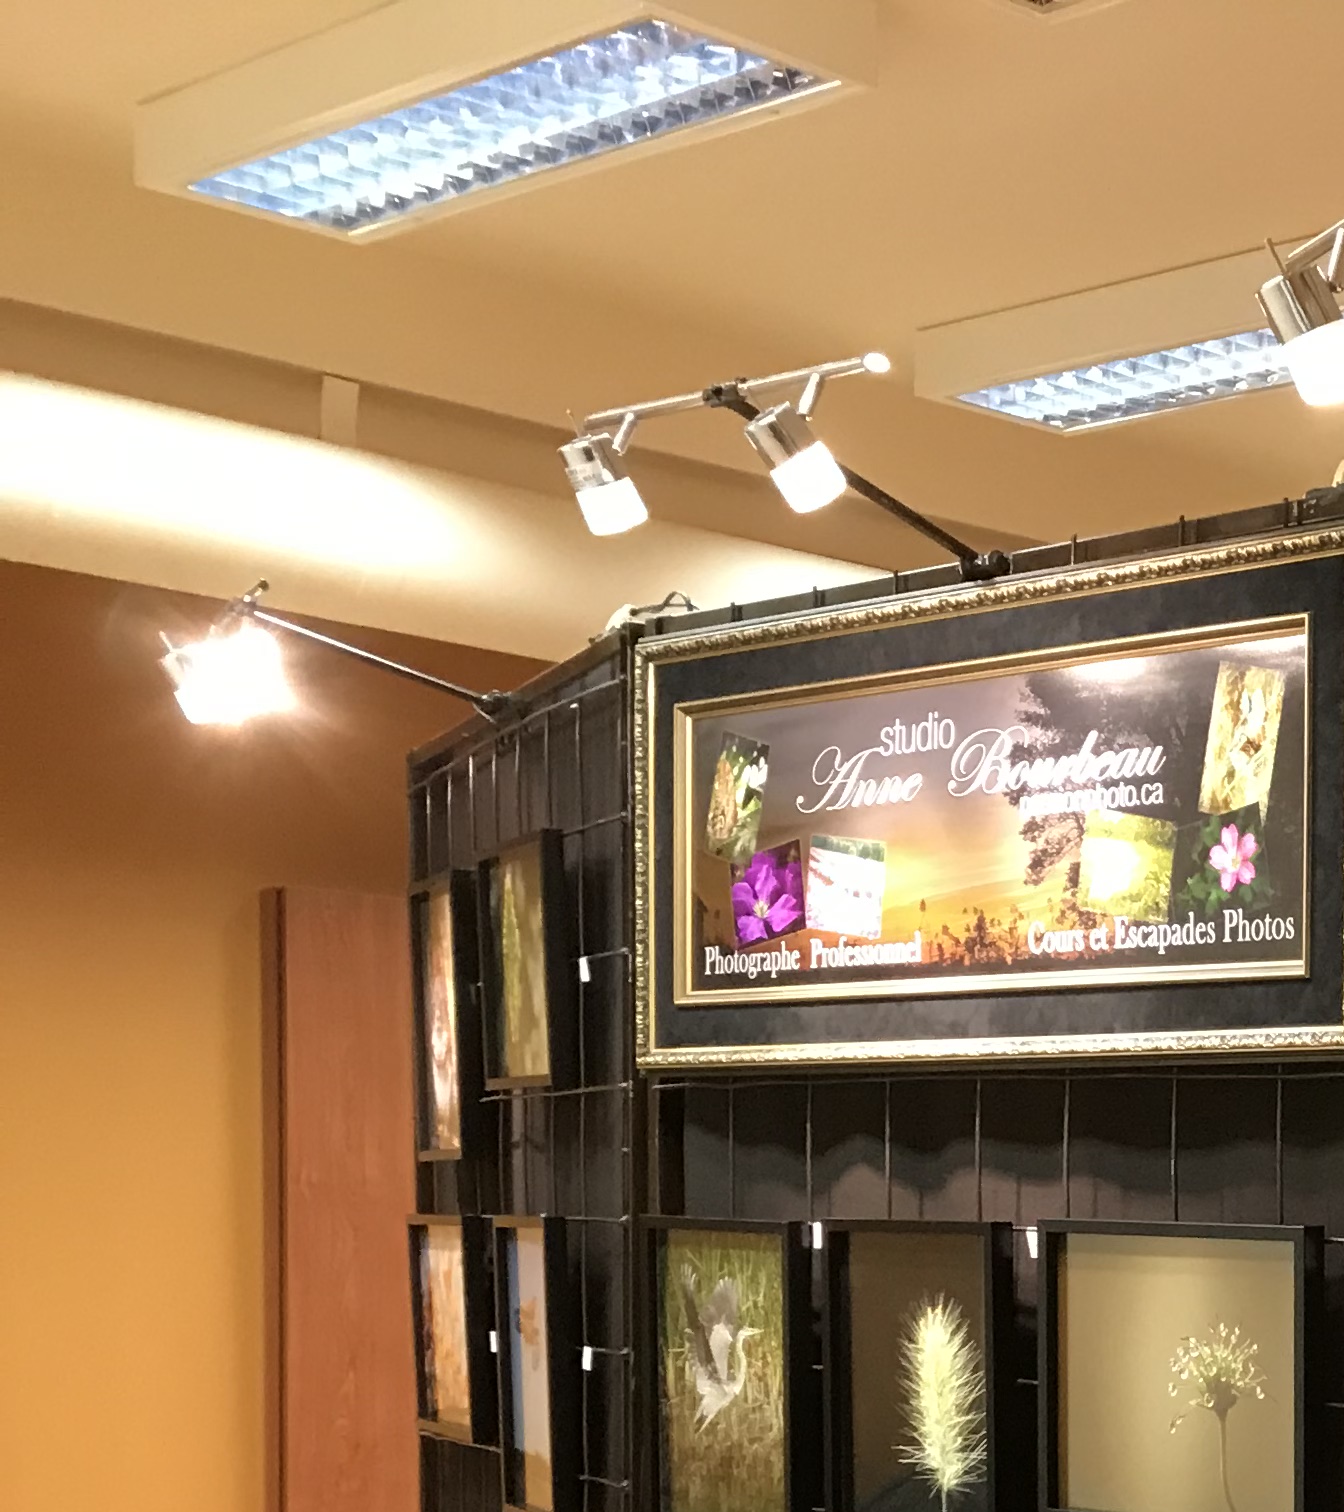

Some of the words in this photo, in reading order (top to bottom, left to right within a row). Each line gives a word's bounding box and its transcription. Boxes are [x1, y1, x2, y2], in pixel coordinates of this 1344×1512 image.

[879, 711, 956, 757] studio
[796, 745, 924, 814] Anne
[947, 725, 1167, 797] Bourbeau
[704, 941, 801, 979] Photographe
[809, 930, 923, 969] Professionnel
[1027, 919, 1085, 954] Cours
[1089, 923, 1109, 950] et
[1113, 911, 1216, 954] Escapades
[1222, 908, 1295, 943] Photos
